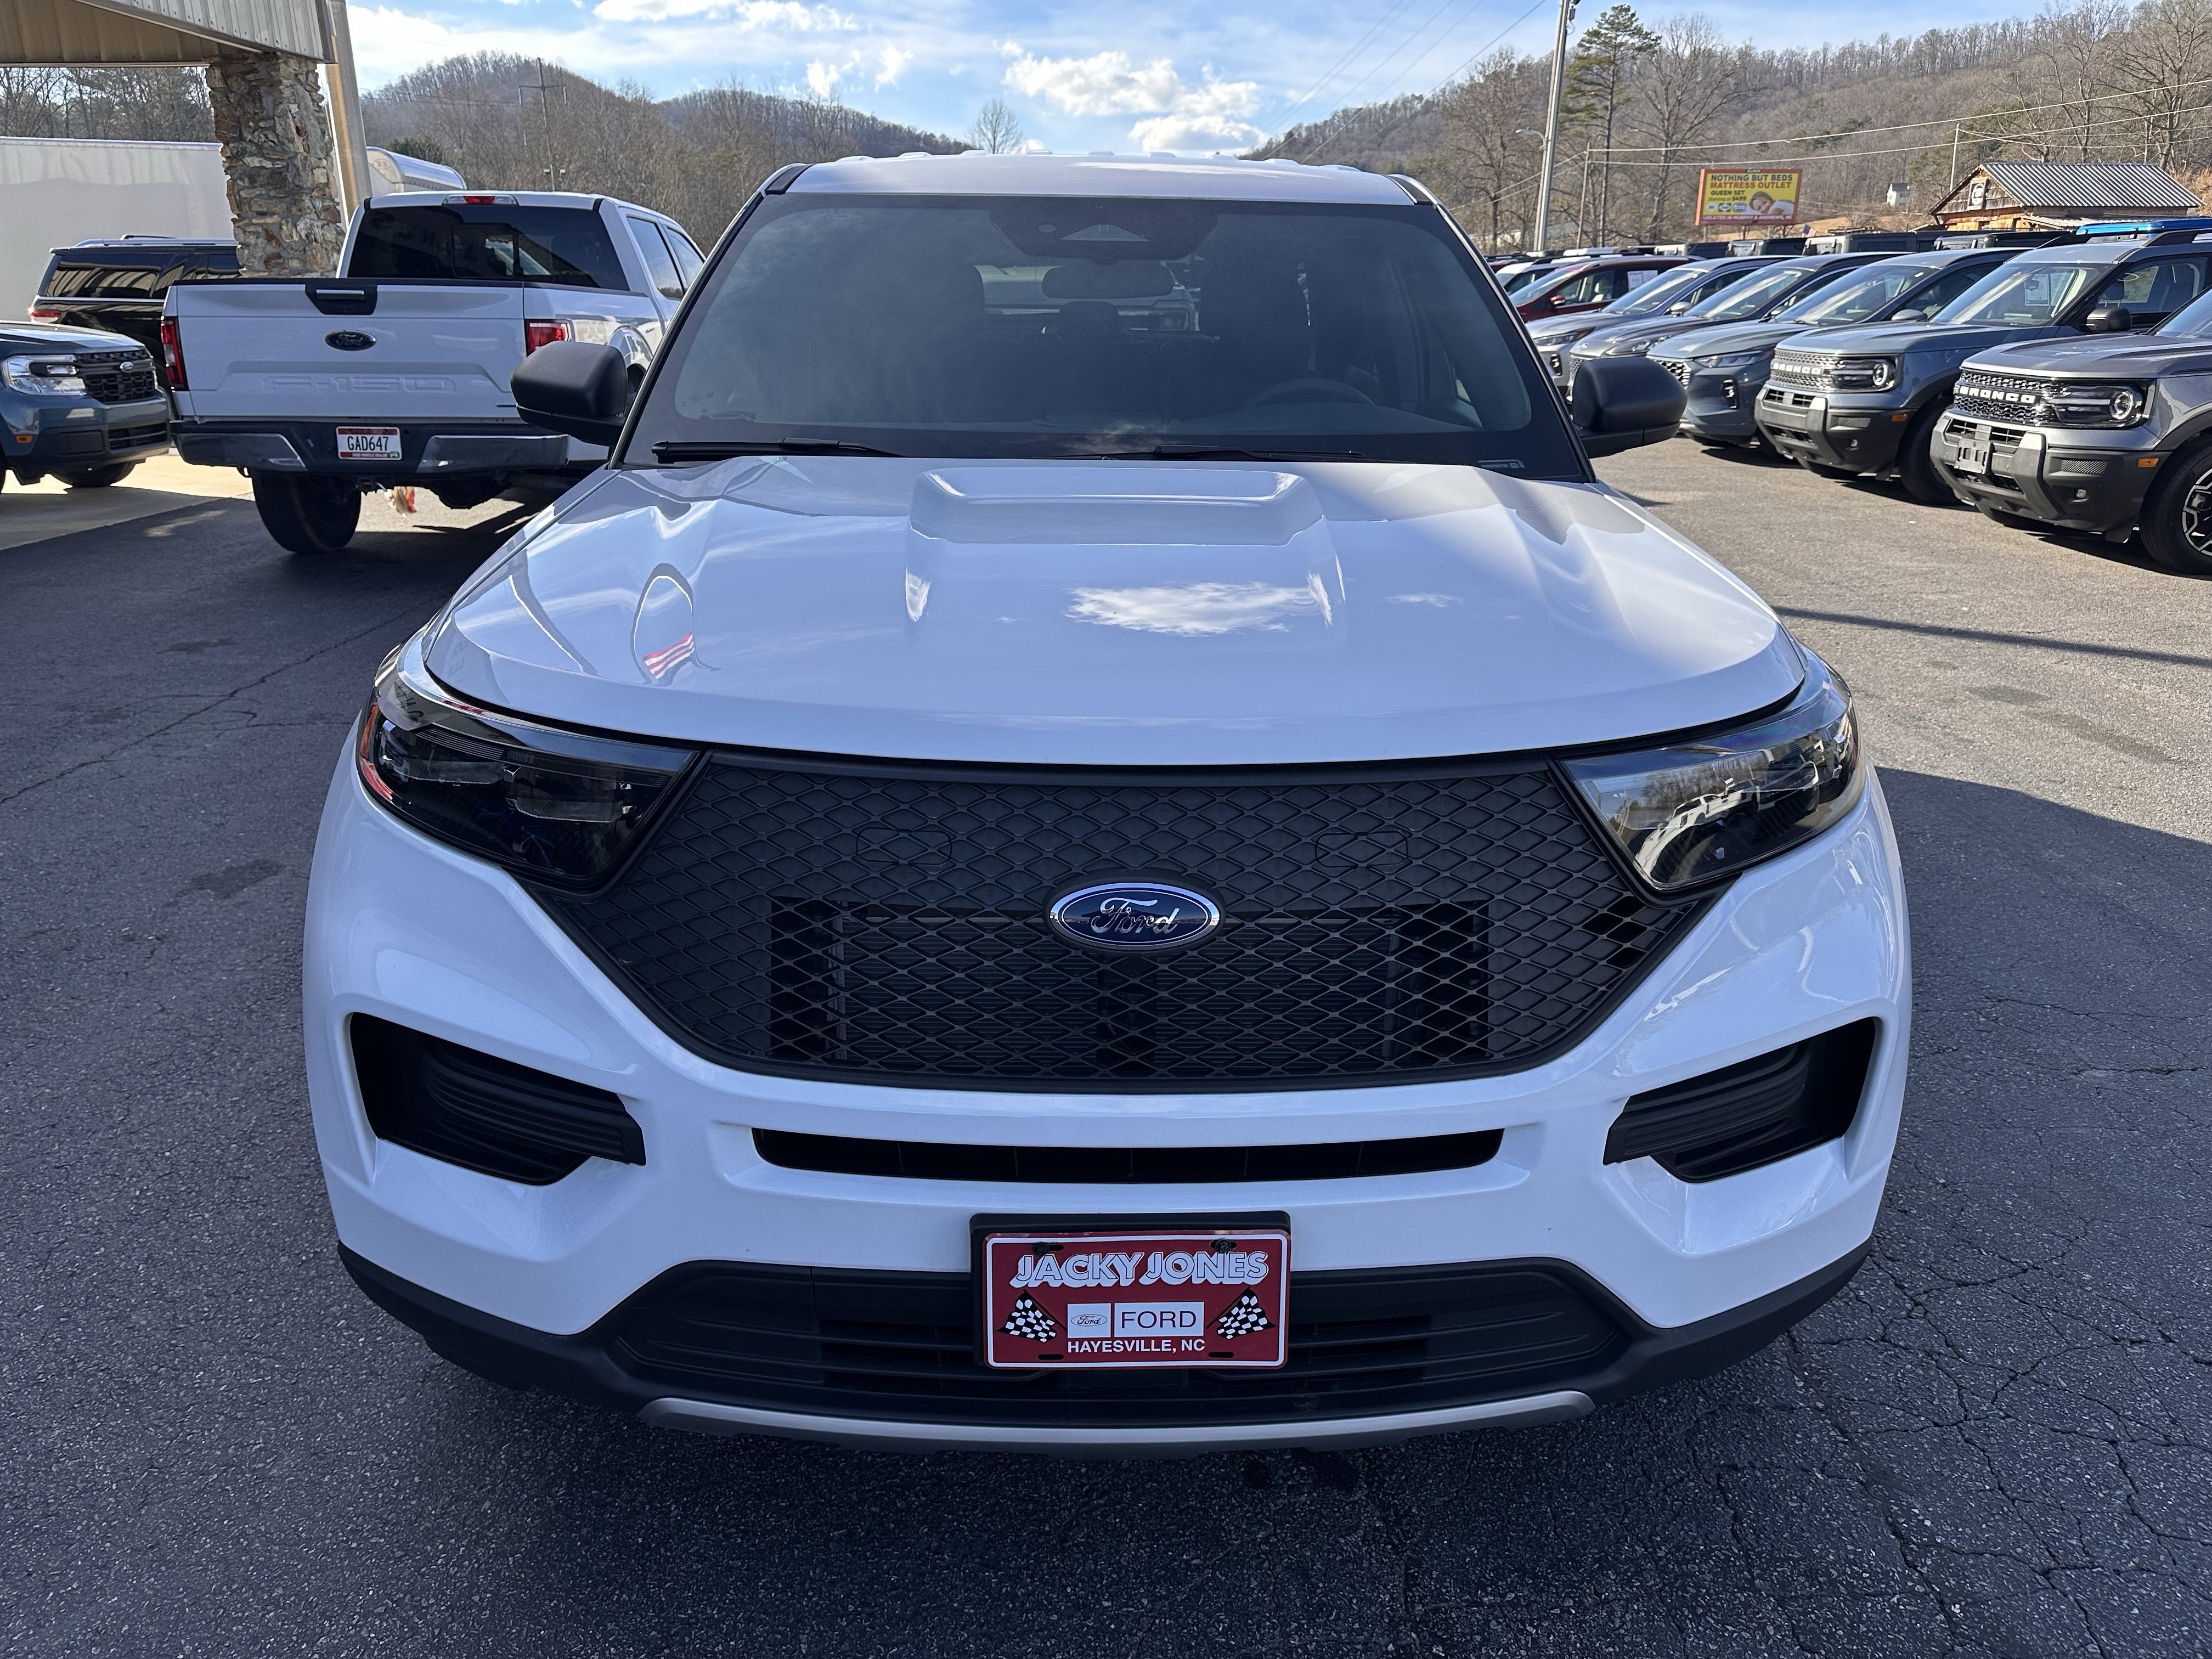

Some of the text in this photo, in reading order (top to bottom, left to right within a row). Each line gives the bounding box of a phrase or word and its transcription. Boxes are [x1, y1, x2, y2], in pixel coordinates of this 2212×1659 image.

[262, 376, 456, 393] F-150
[1959, 386, 2036, 404] BRONCO
[347, 436, 389, 451] GAD647
[1091, 898, 1180, 933] Ford
[1009, 1251, 1269, 1288] JACKY JONES
[1077, 1314, 1102, 1326] Ford
[1121, 1311, 1197, 1329] FORD
[1068, 1339, 1205, 1353] HAYESVILLE, NC
